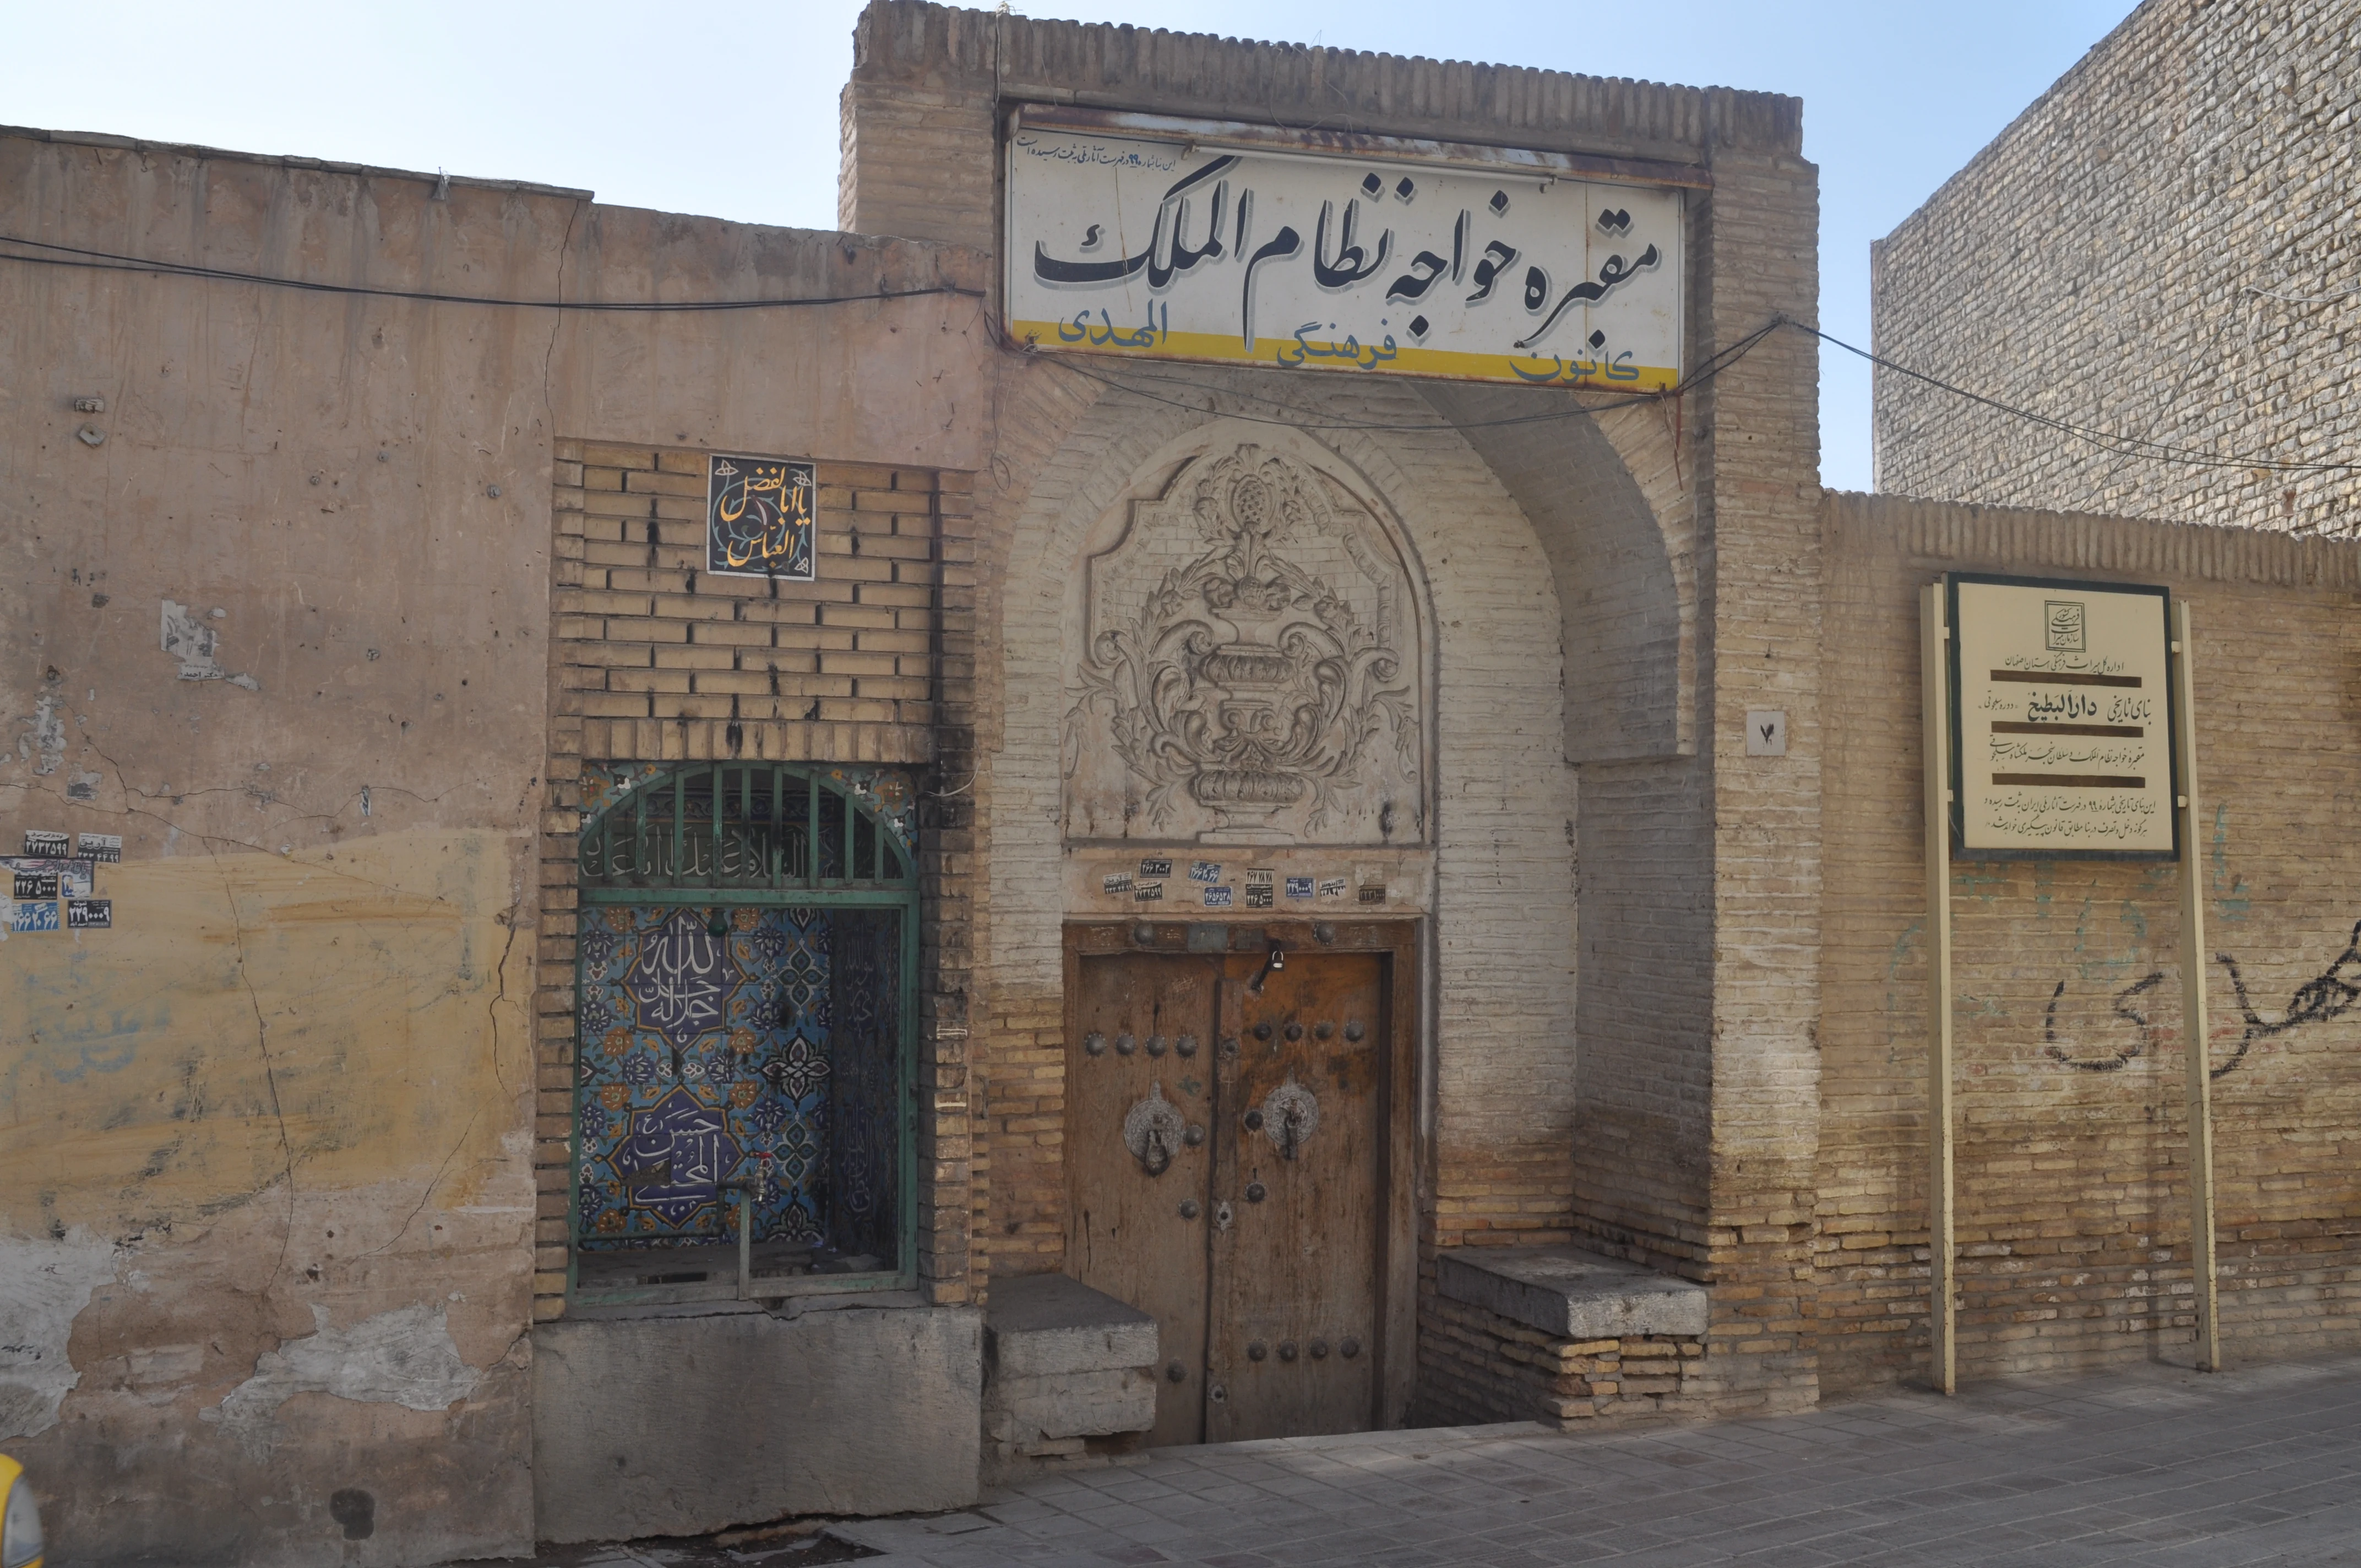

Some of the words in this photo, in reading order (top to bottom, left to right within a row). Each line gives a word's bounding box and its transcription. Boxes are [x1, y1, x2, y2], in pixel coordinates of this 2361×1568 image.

[1016, 137, 1037, 155] است
[1129, 154, 1139, 167] ۹۹
[1242, 172, 1416, 353] نظام
[1386, 189, 1519, 339] خواجه
[1514, 208, 1661, 351] مقبره
[1057, 298, 1168, 349] المهدی
[1277, 317, 1397, 369] فرهنگی
[1510, 348, 1640, 384] کانون
[727, 525, 795, 568] العباس
[2005, 654, 2026, 667] اصفهان
[2024, 657, 2050, 670] استان
[2050, 652, 2066, 671] فرهنگی
[2065, 655, 2101, 673] میراث
[2107, 661, 2124, 672] اداره
[2107, 694, 2131, 723] تاریخی
[2130, 698, 2152, 726] بنای
[2047, 748, 2069, 765] سلطان
[2097, 749, 2113, 771] نظام
[2112, 747, 2127, 767] خواجه
[1989, 798, 2003, 812] رسیده
[2021, 798, 2039, 812] ایران
[2046, 796, 2063, 810] آثار
[2059, 796, 2081, 813] فهرست
[2088, 801, 2099, 812] ۹۹
[2115, 795, 2134, 814] تاریخی
[2131, 797, 2145, 813] بنای
[2144, 800, 2156, 815] این
[2017, 813, 2048, 837] پیگیری
[2044, 819, 2066, 835] قانون
[2064, 821, 2083, 836] مطابق
[2098, 820, 2117, 837] تصرف
[79, 836, 106, 849] آرین
[110, 854, 119, 863] ۹۹
[15, 880, 33, 894] ۲۲۶
[35, 880, 56, 895] ۵۰۰۰
[1259, 895, 1272, 905] ۵۰۰۰
[43, 911, 58, 930] ۶۶
[69, 906, 110, 922] ۲۲۹۰۰۰۹
